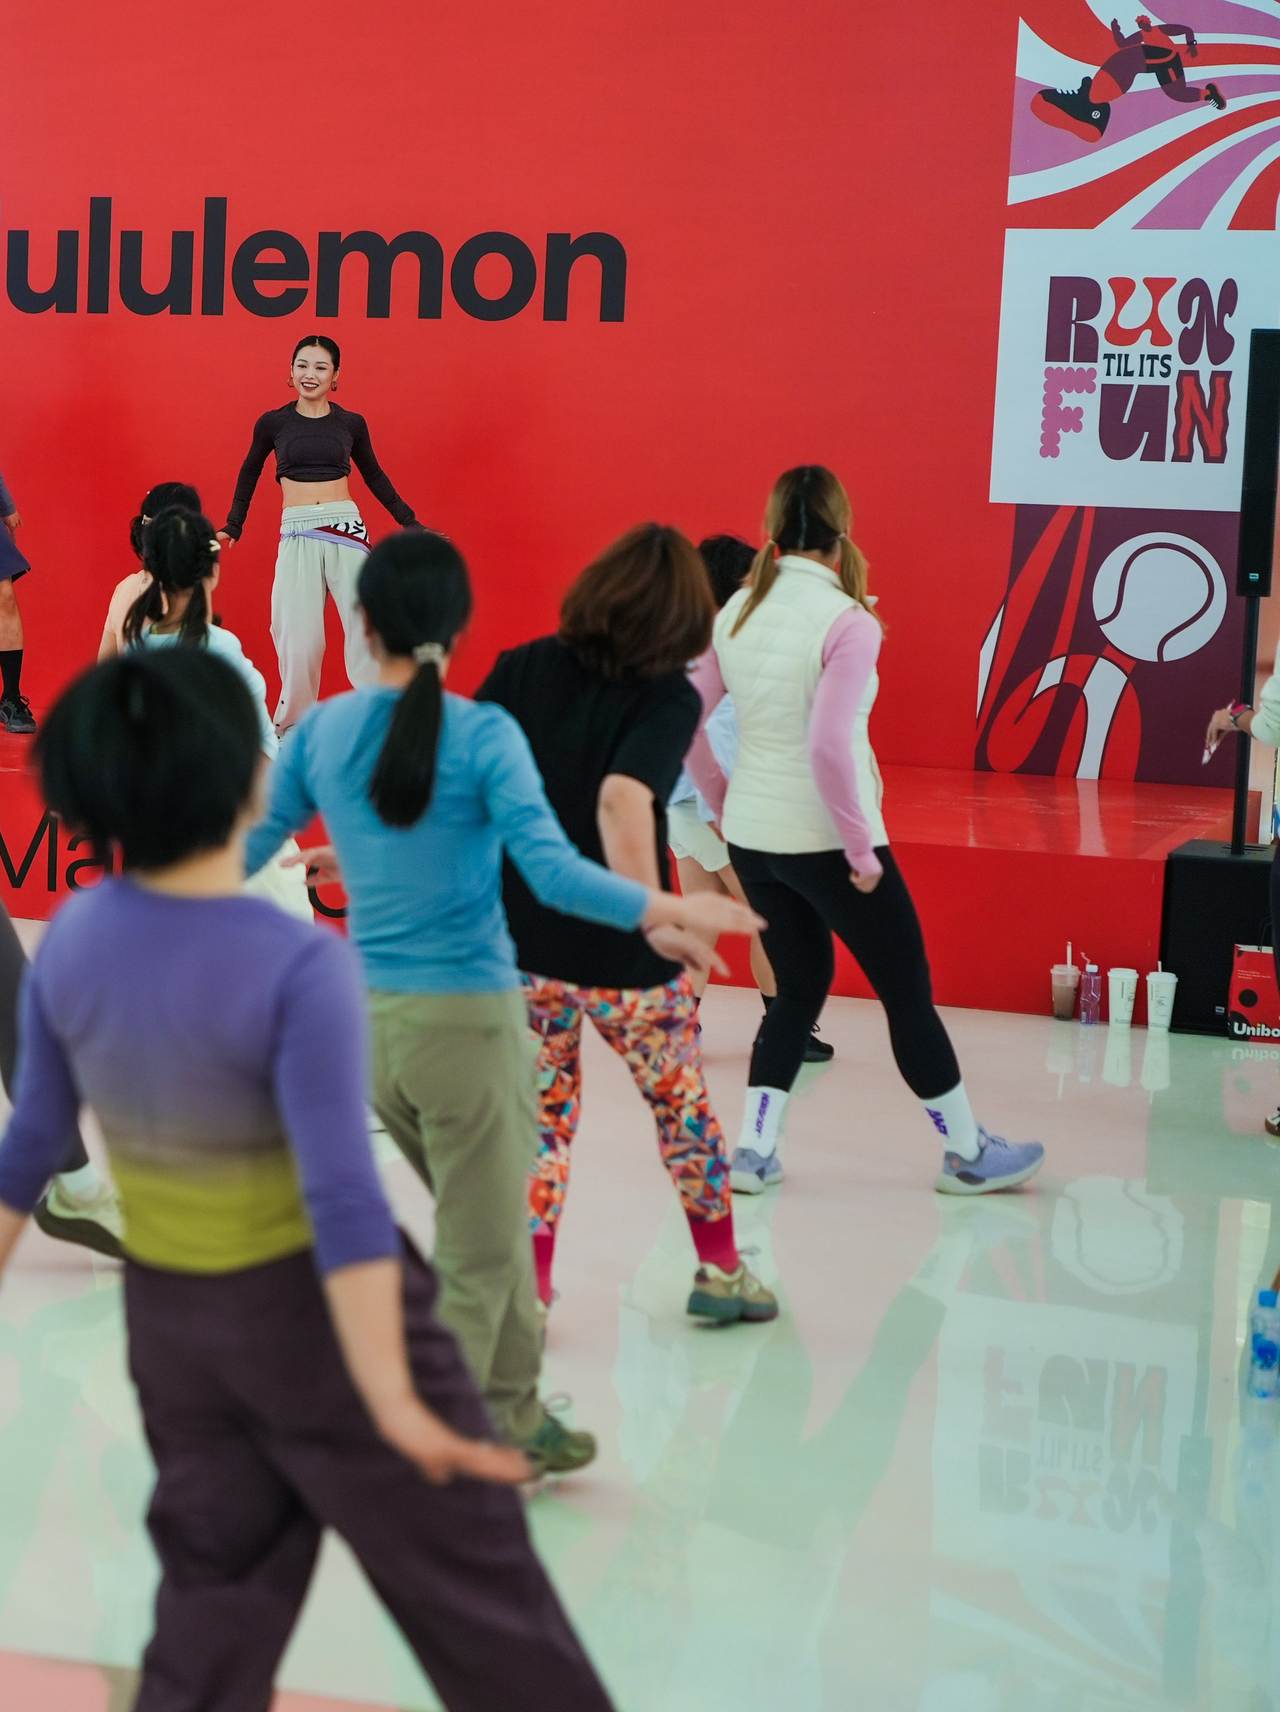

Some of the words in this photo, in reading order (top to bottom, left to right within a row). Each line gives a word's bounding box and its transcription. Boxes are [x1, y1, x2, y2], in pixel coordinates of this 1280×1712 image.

[1045, 275, 1239, 366] RUN
[1102, 353, 1135, 377] TIL
[1138, 353, 1173, 378] ITS
[1039, 366, 1233, 464] FUN
